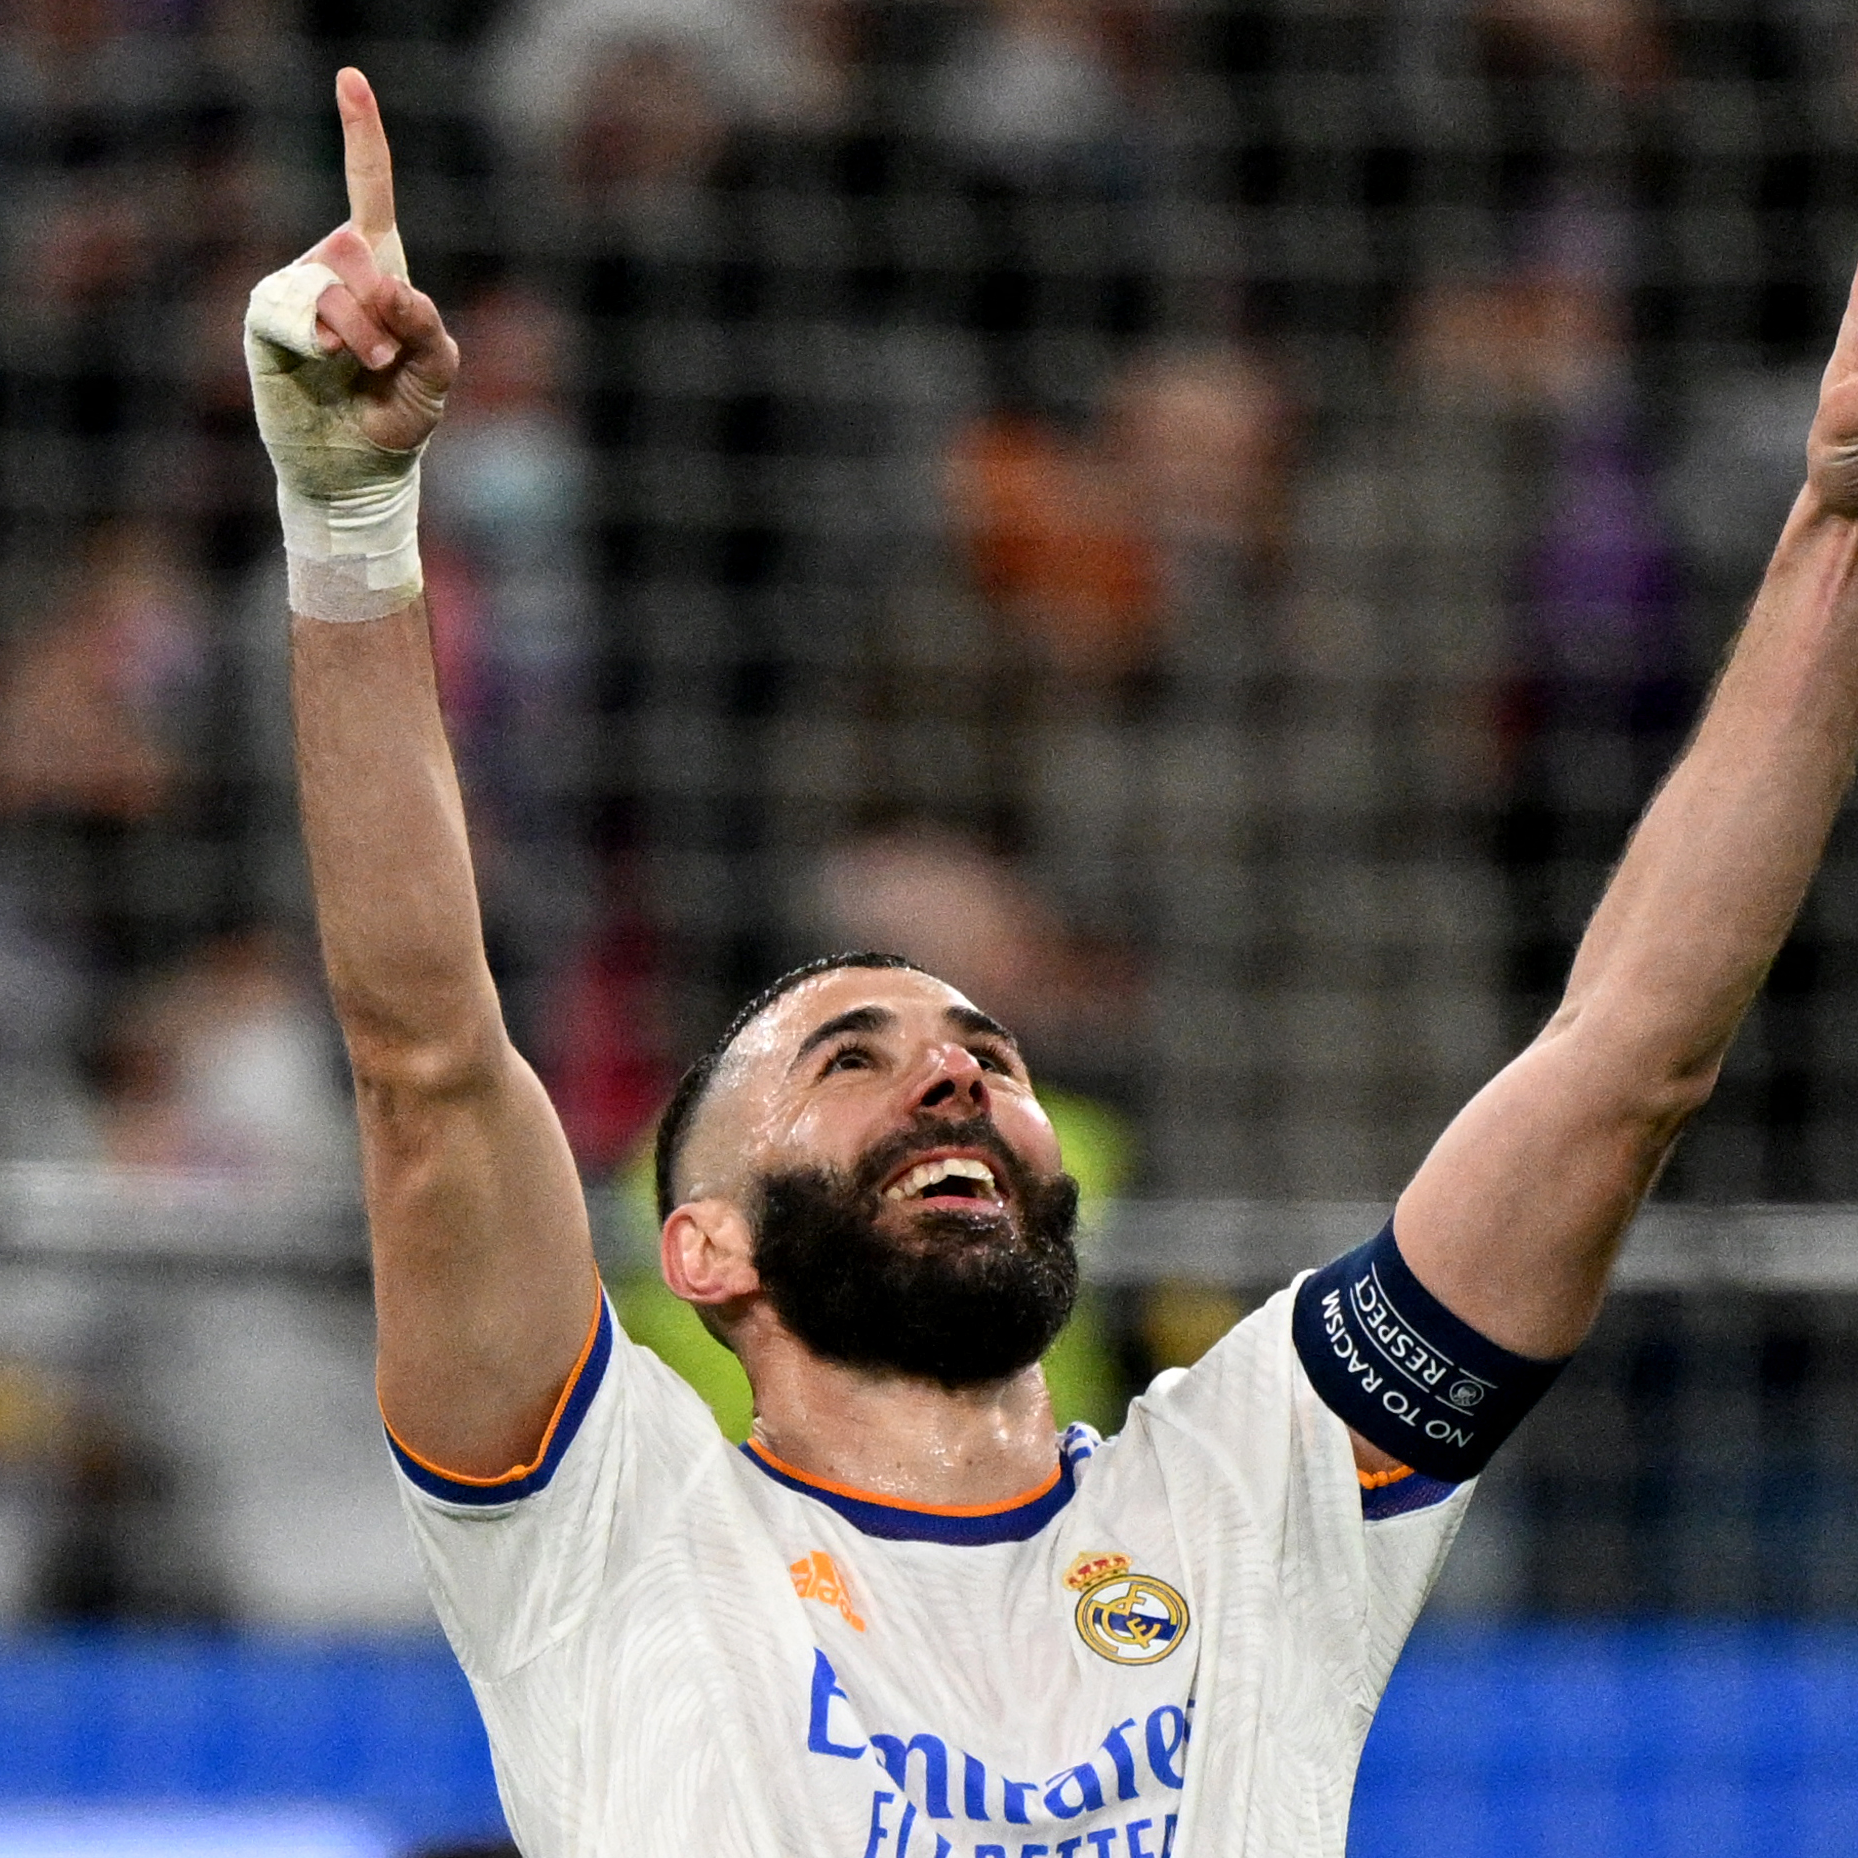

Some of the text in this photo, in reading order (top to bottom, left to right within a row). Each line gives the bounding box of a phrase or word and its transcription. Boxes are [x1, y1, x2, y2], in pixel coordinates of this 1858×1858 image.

[1321, 1288, 1475, 1449] NO TO RACISM
[1353, 1274, 1447, 1387] RESPECT
[807, 1646, 1195, 1825] Emirate
